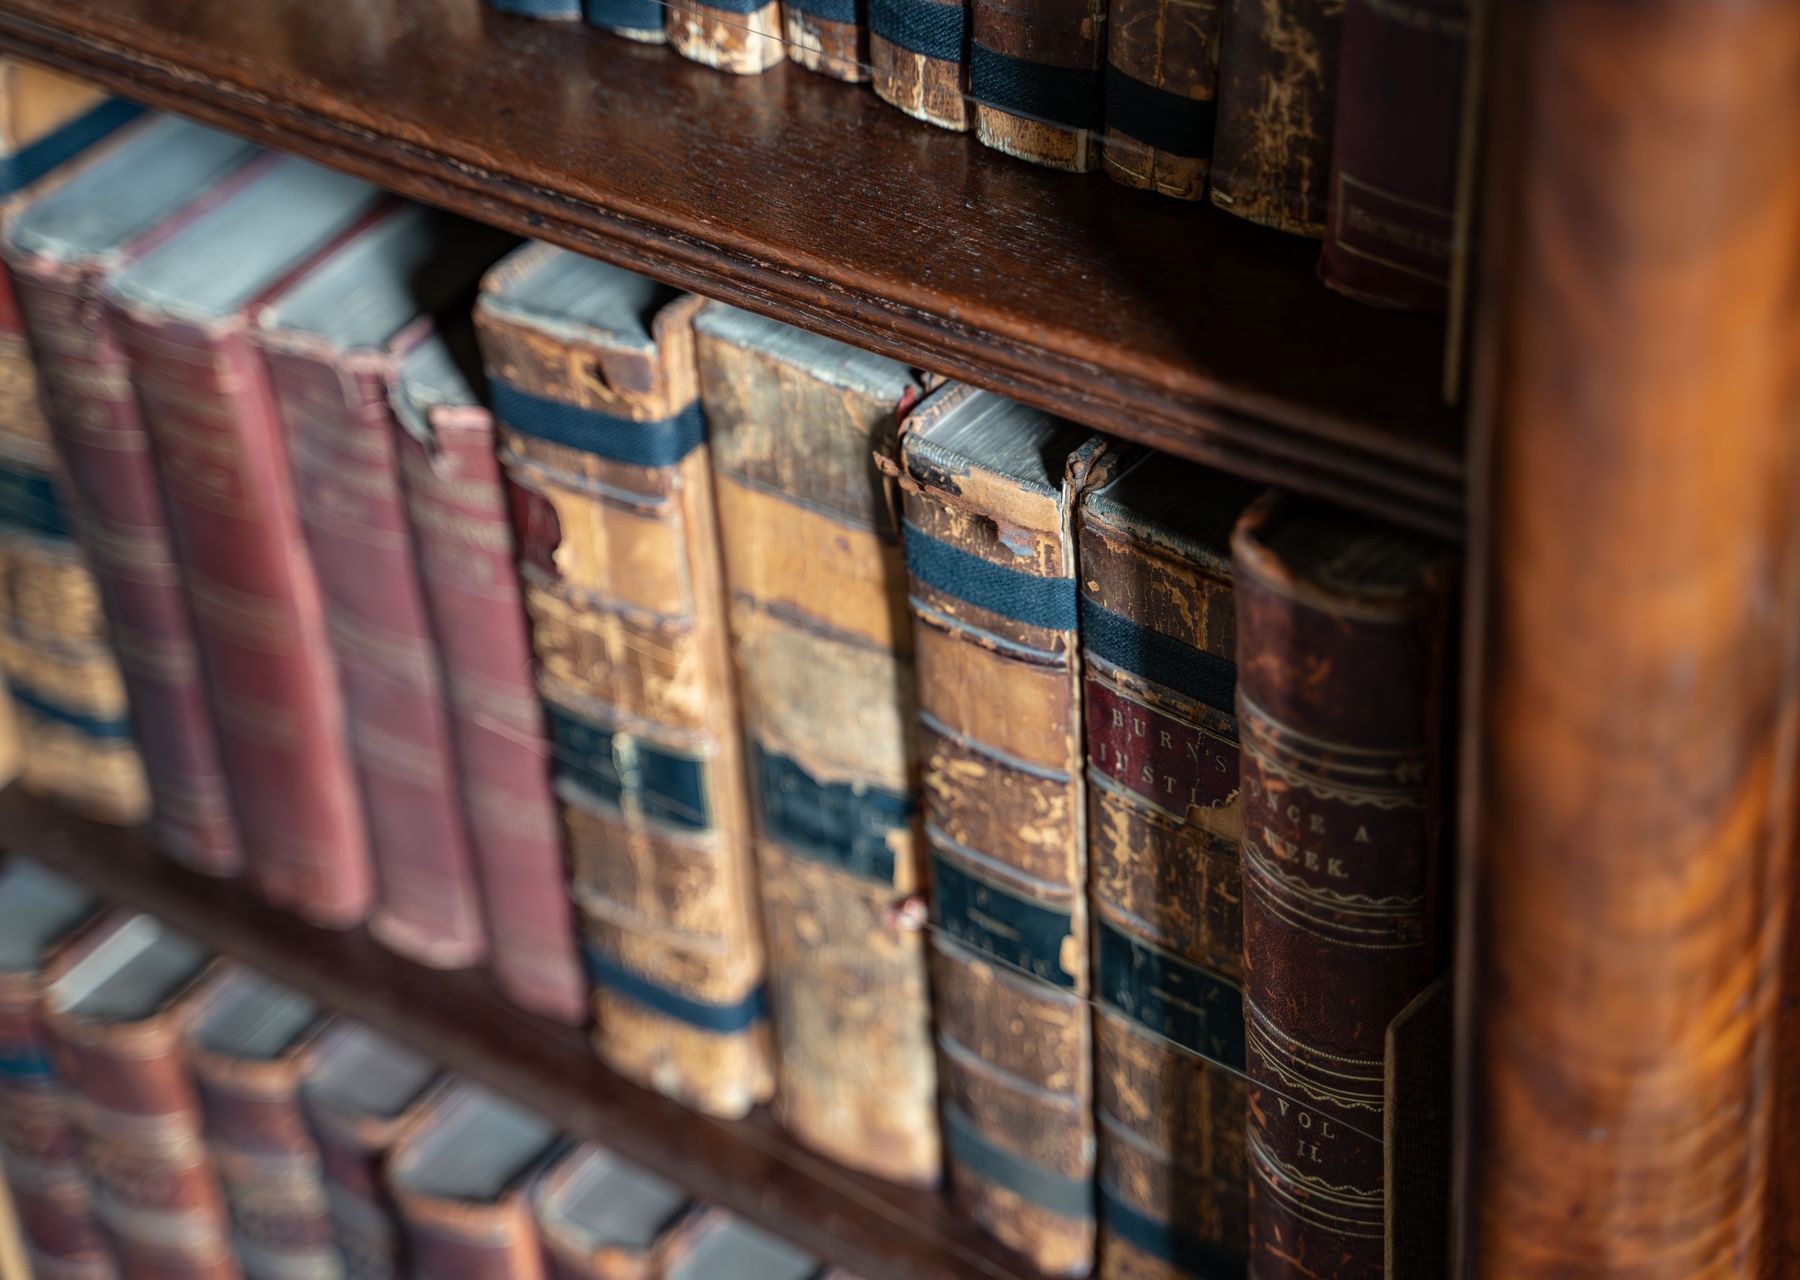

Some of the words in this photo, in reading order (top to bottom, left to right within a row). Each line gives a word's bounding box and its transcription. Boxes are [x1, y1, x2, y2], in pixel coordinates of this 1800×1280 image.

[1112, 708, 1227, 773] BURN'S
[1354, 825, 1370, 842] A
[1277, 1097, 1335, 1139] VOL
